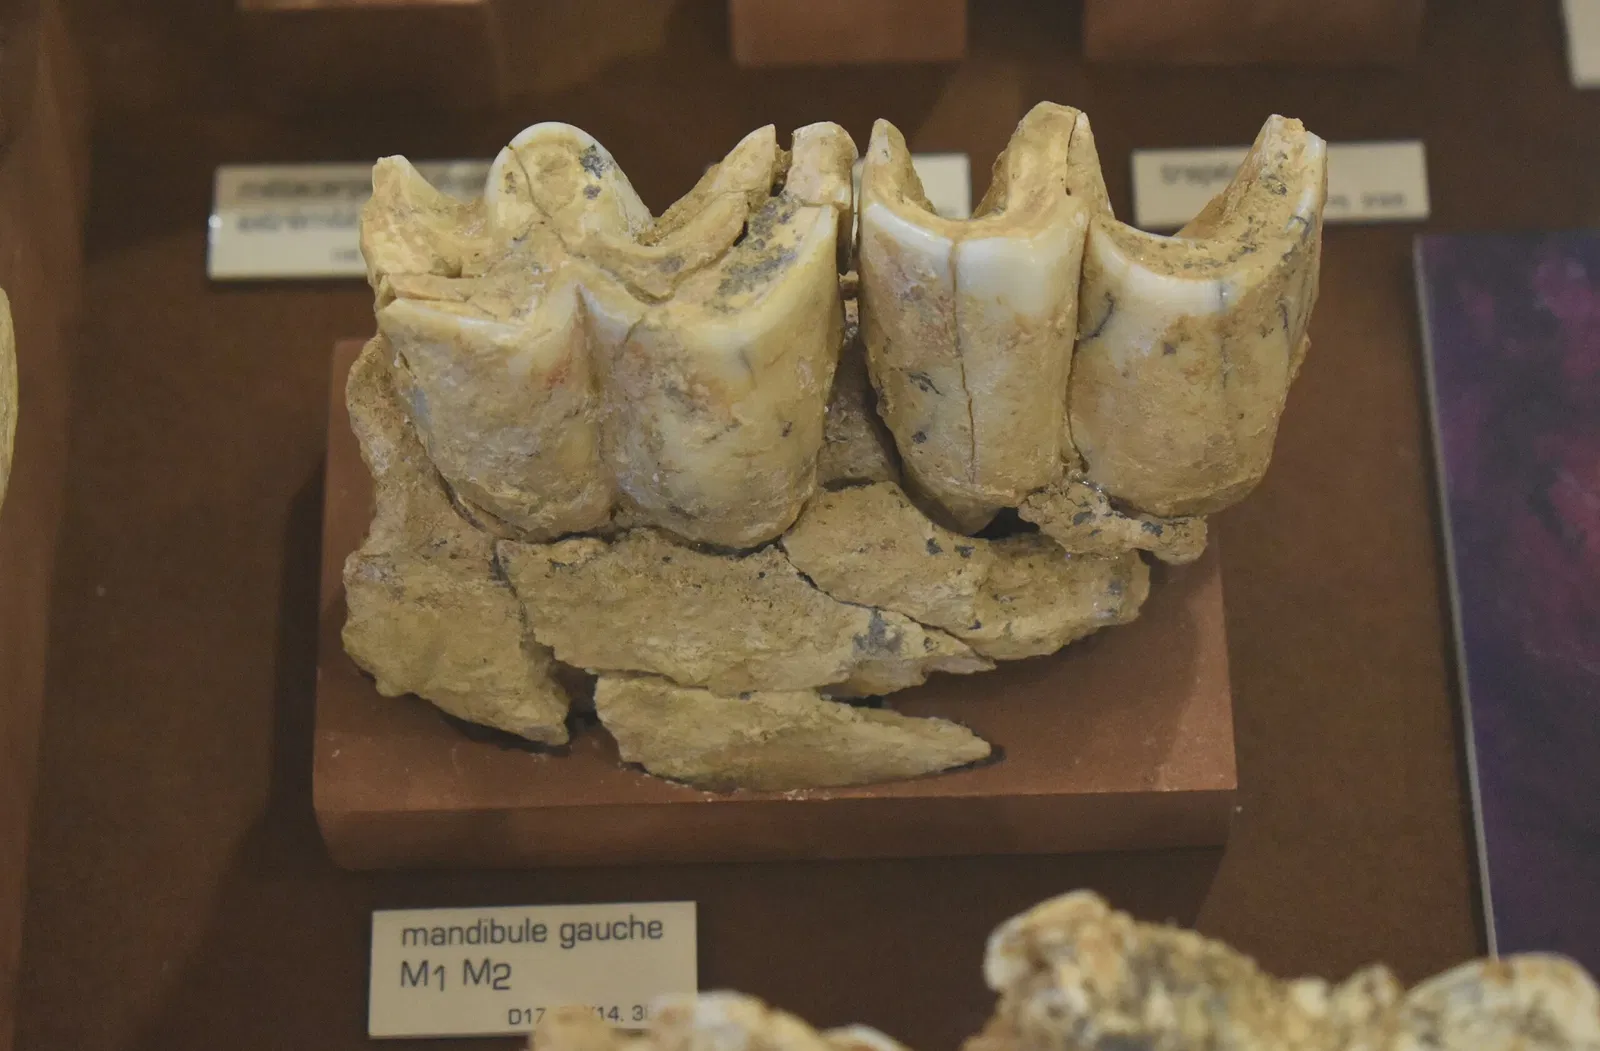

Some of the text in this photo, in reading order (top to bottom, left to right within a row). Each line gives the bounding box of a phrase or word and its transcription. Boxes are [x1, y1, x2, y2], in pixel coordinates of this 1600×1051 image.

[402, 914, 663, 949] mandibule gauche
[400, 958, 512, 992] M1 M2
